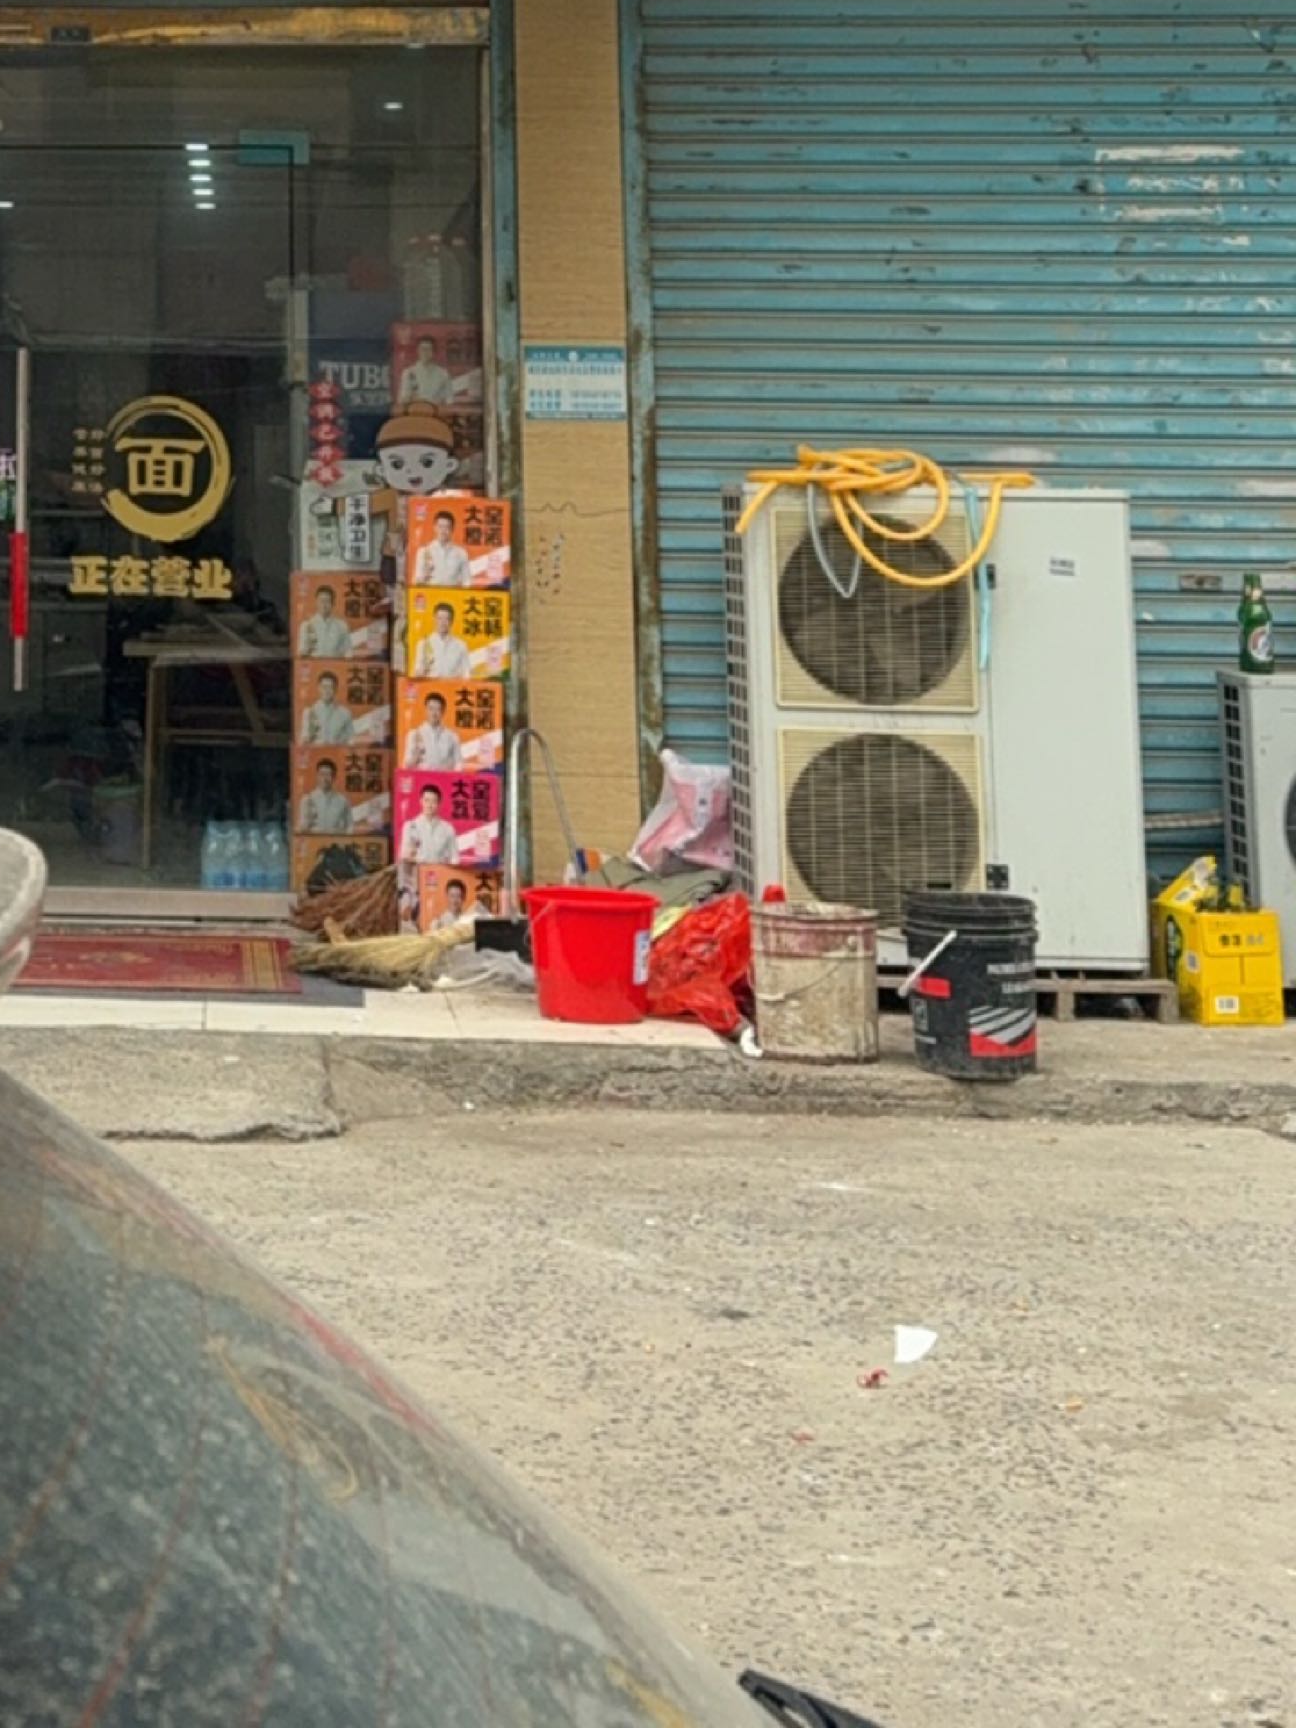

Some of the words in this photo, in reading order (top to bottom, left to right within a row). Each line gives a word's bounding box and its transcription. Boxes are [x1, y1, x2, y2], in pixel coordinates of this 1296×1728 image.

[114, 437, 208, 497] 面
[68, 555, 233, 599] 正在营业
